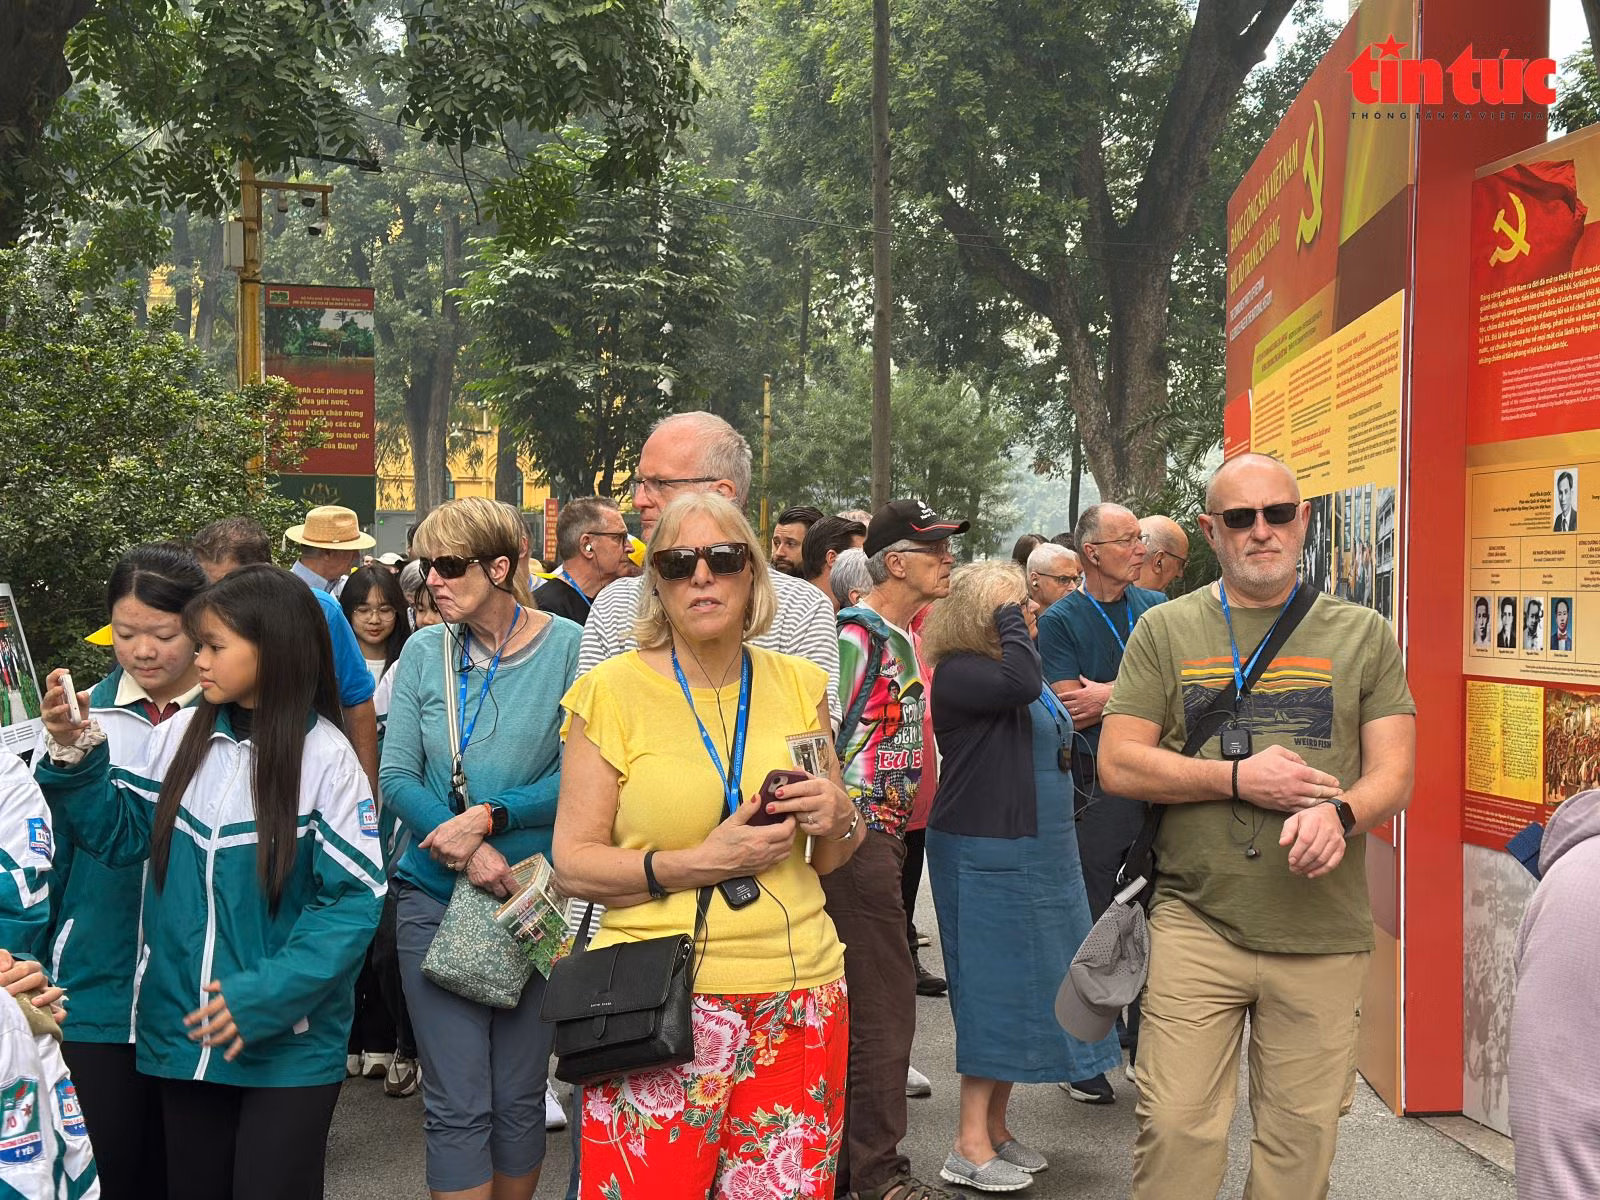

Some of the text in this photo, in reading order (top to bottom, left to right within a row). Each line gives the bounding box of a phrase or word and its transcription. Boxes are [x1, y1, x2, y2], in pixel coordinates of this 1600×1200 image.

[1294, 737, 1332, 748] WEIRD FISH
[878, 750, 908, 770] EU
